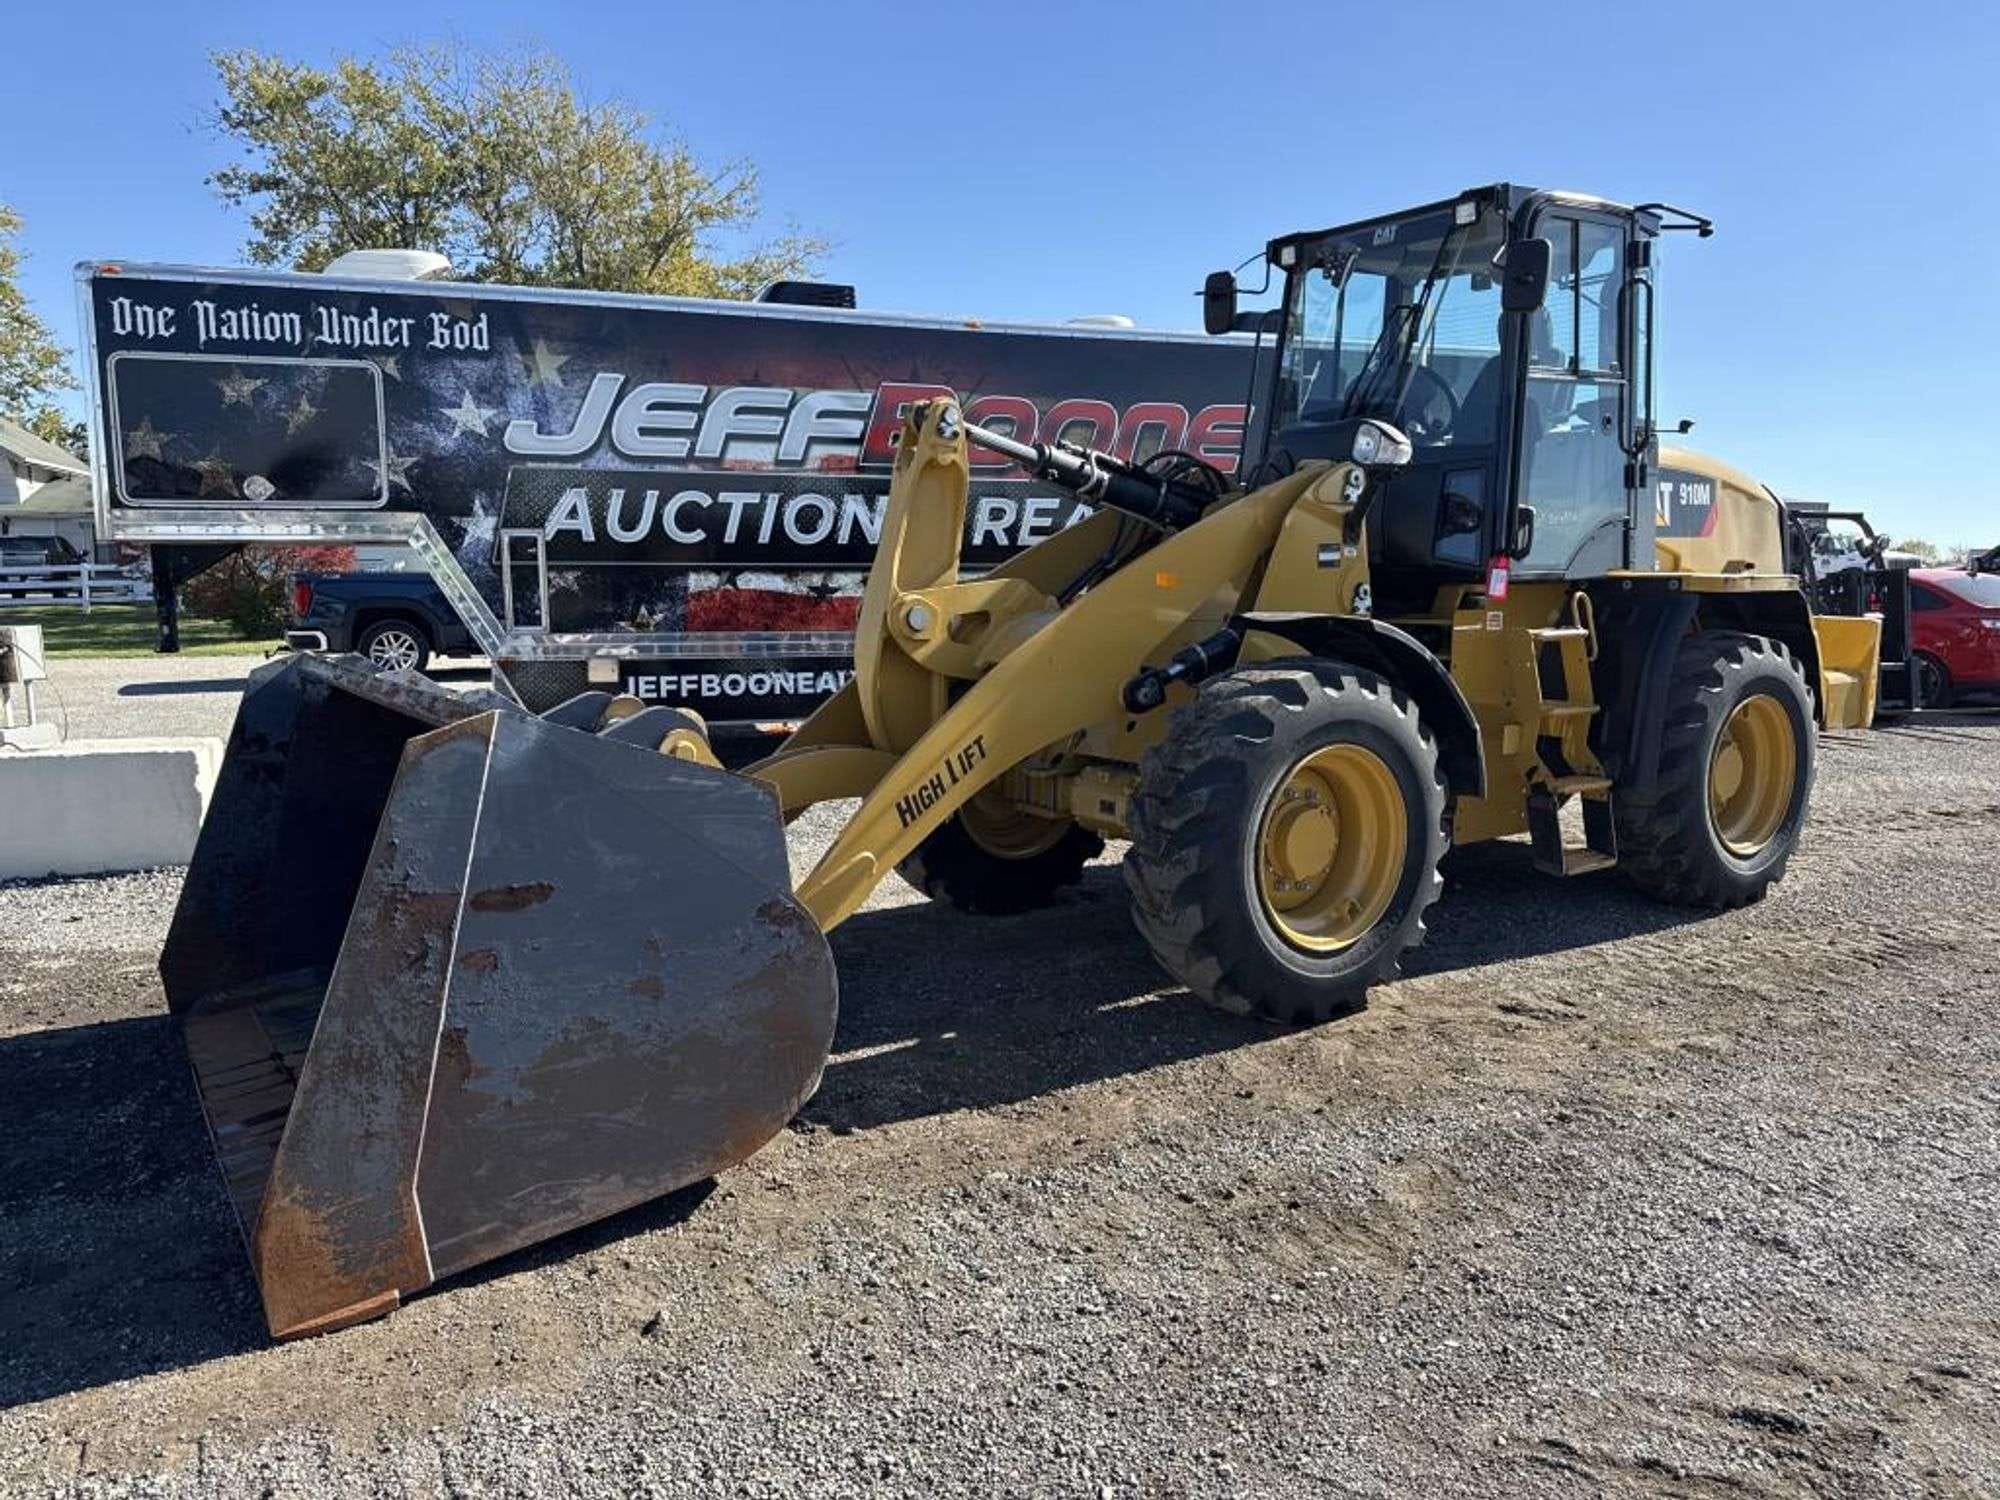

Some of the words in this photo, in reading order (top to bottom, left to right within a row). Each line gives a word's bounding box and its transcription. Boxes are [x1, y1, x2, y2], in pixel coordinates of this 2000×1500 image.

[110, 297, 176, 339] One
[188, 300, 300, 349] Nation
[312, 306, 415, 348] Under
[424, 312, 490, 351] God
[545, 488, 889, 545] AUCTION
[895, 773, 946, 828] HIGH
[944, 734, 986, 785] LIFT
